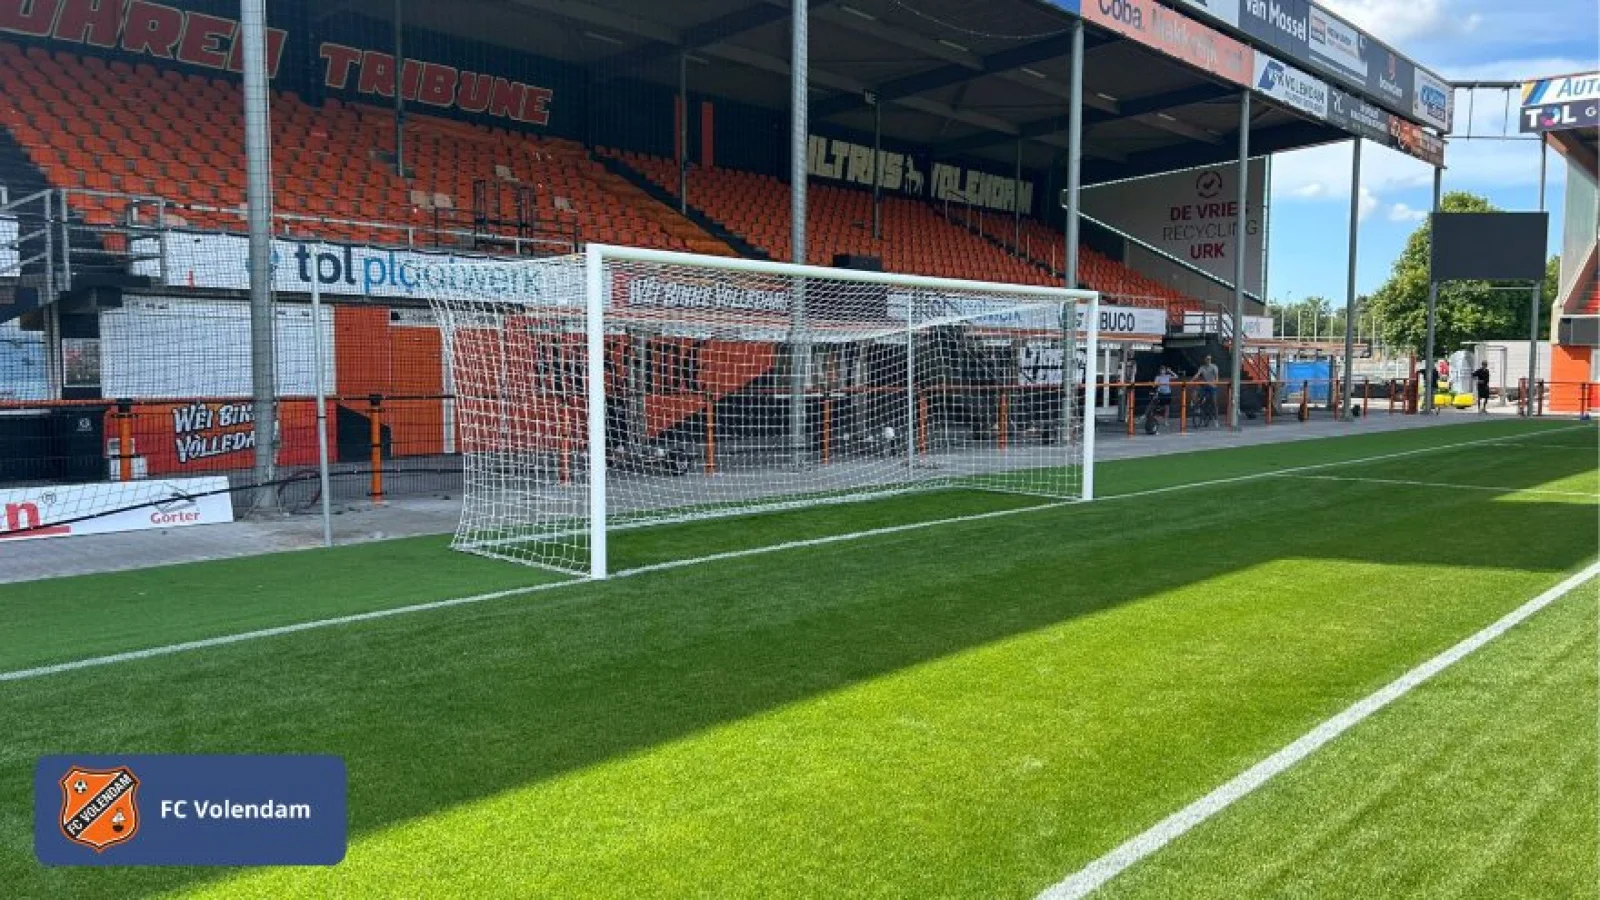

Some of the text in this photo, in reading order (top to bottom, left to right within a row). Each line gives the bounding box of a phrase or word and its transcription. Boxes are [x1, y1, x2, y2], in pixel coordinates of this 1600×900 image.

[1268, 0, 1307, 42] Mossel
[319, 41, 553, 125] TRIBUNE
[1556, 76, 1600, 99] AUT
[931, 161, 1034, 215] VOLENDAM
[1170, 205, 1192, 221] DE
[294, 243, 356, 286] tol
[1190, 242, 1225, 260] URK
[219, 403, 256, 426] BIN
